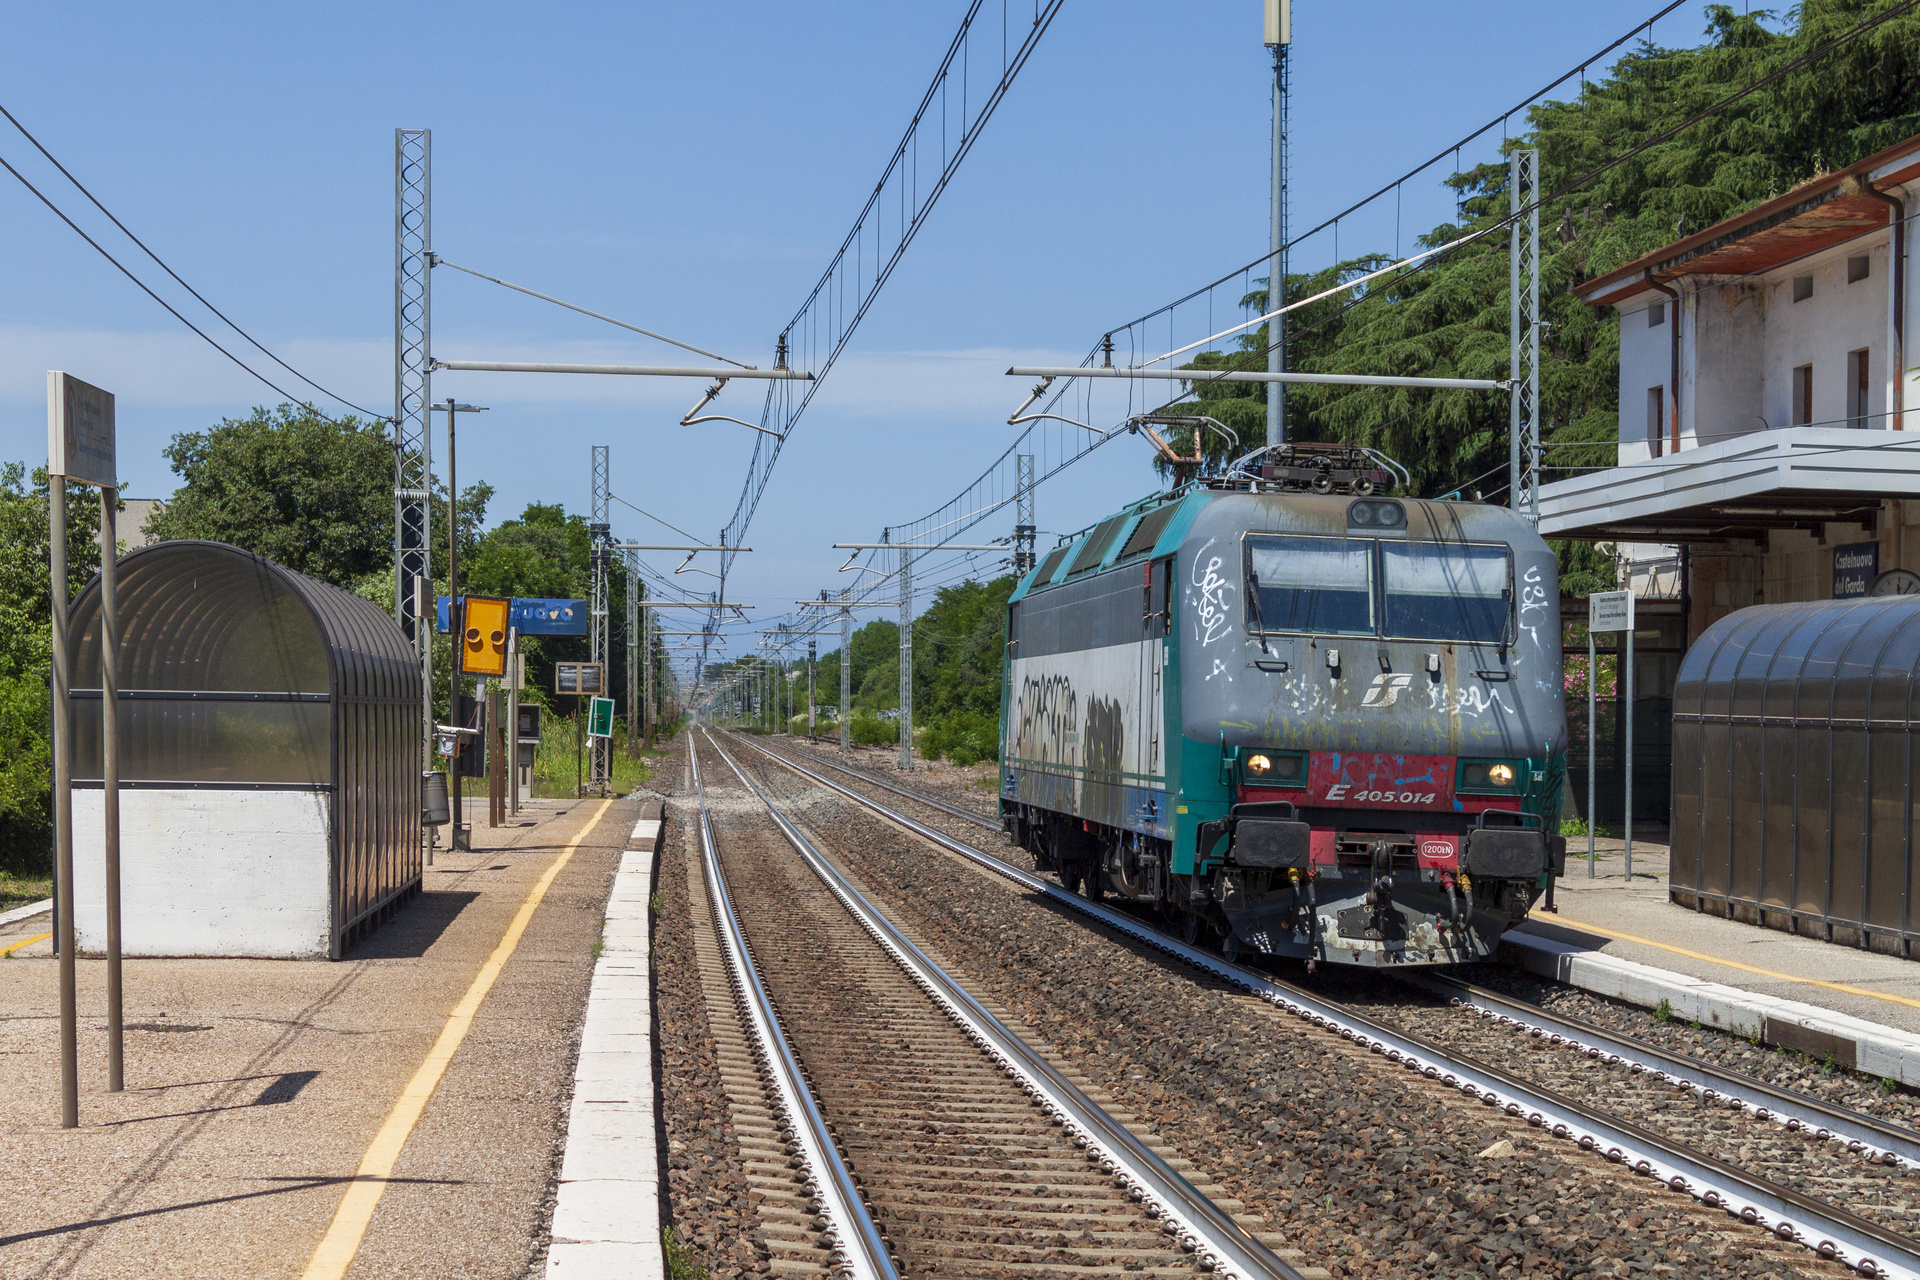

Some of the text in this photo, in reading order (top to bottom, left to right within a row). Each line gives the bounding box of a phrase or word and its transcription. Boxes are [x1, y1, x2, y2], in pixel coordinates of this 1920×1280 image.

[1835, 551, 1873, 569] Castelnuovo
[1834, 575, 1865, 594] del Garda
[1325, 784, 1436, 804] E 405.014
[1424, 844, 1451, 854] 1200kN
